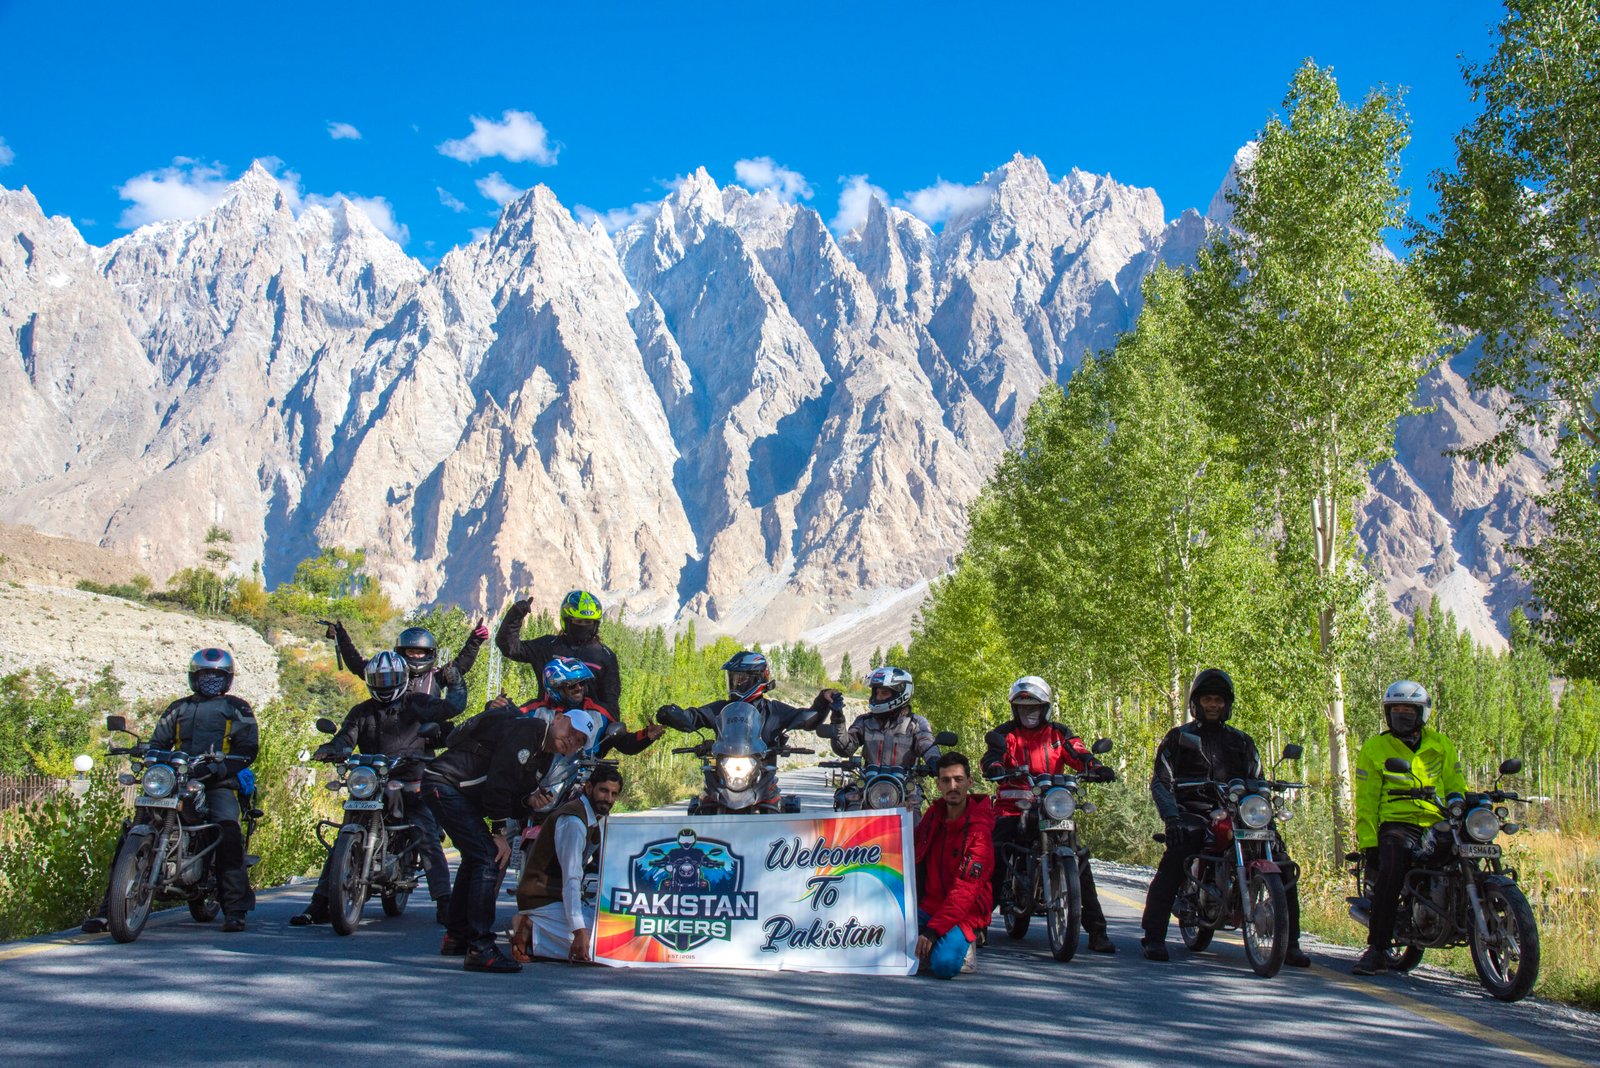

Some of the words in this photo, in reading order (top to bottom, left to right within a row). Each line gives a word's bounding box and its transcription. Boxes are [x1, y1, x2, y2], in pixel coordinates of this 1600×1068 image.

[765, 837, 882, 871] Welcome
[614, 891, 754, 917] PAKISTAN
[806, 875, 845, 911] To
[639, 918, 727, 938] BIKERS
[760, 914, 885, 953] Pakistan
